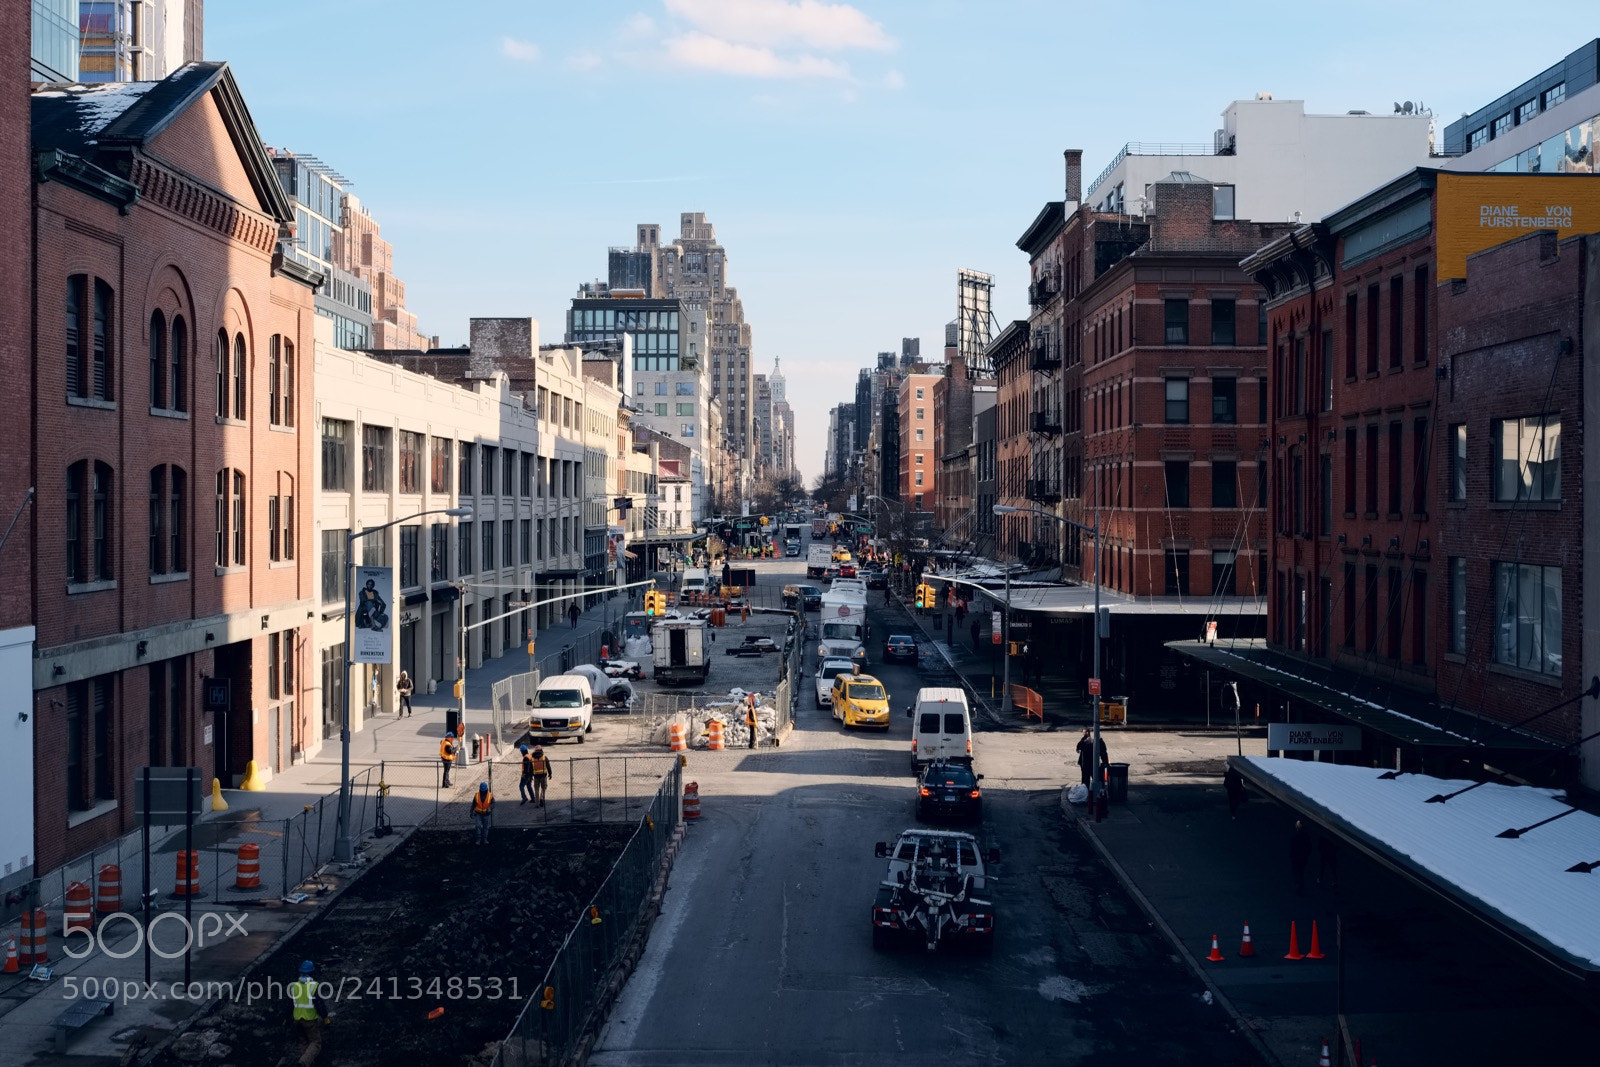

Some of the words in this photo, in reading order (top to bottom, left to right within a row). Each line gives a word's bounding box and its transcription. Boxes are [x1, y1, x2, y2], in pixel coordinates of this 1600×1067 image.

[1480, 205, 1518, 216] DIANE
[1545, 206, 1572, 217] VON
[1480, 217, 1572, 228] FURSTENBERG
[1289, 730, 1312, 738] DIANE
[1327, 730, 1344, 738] VON
